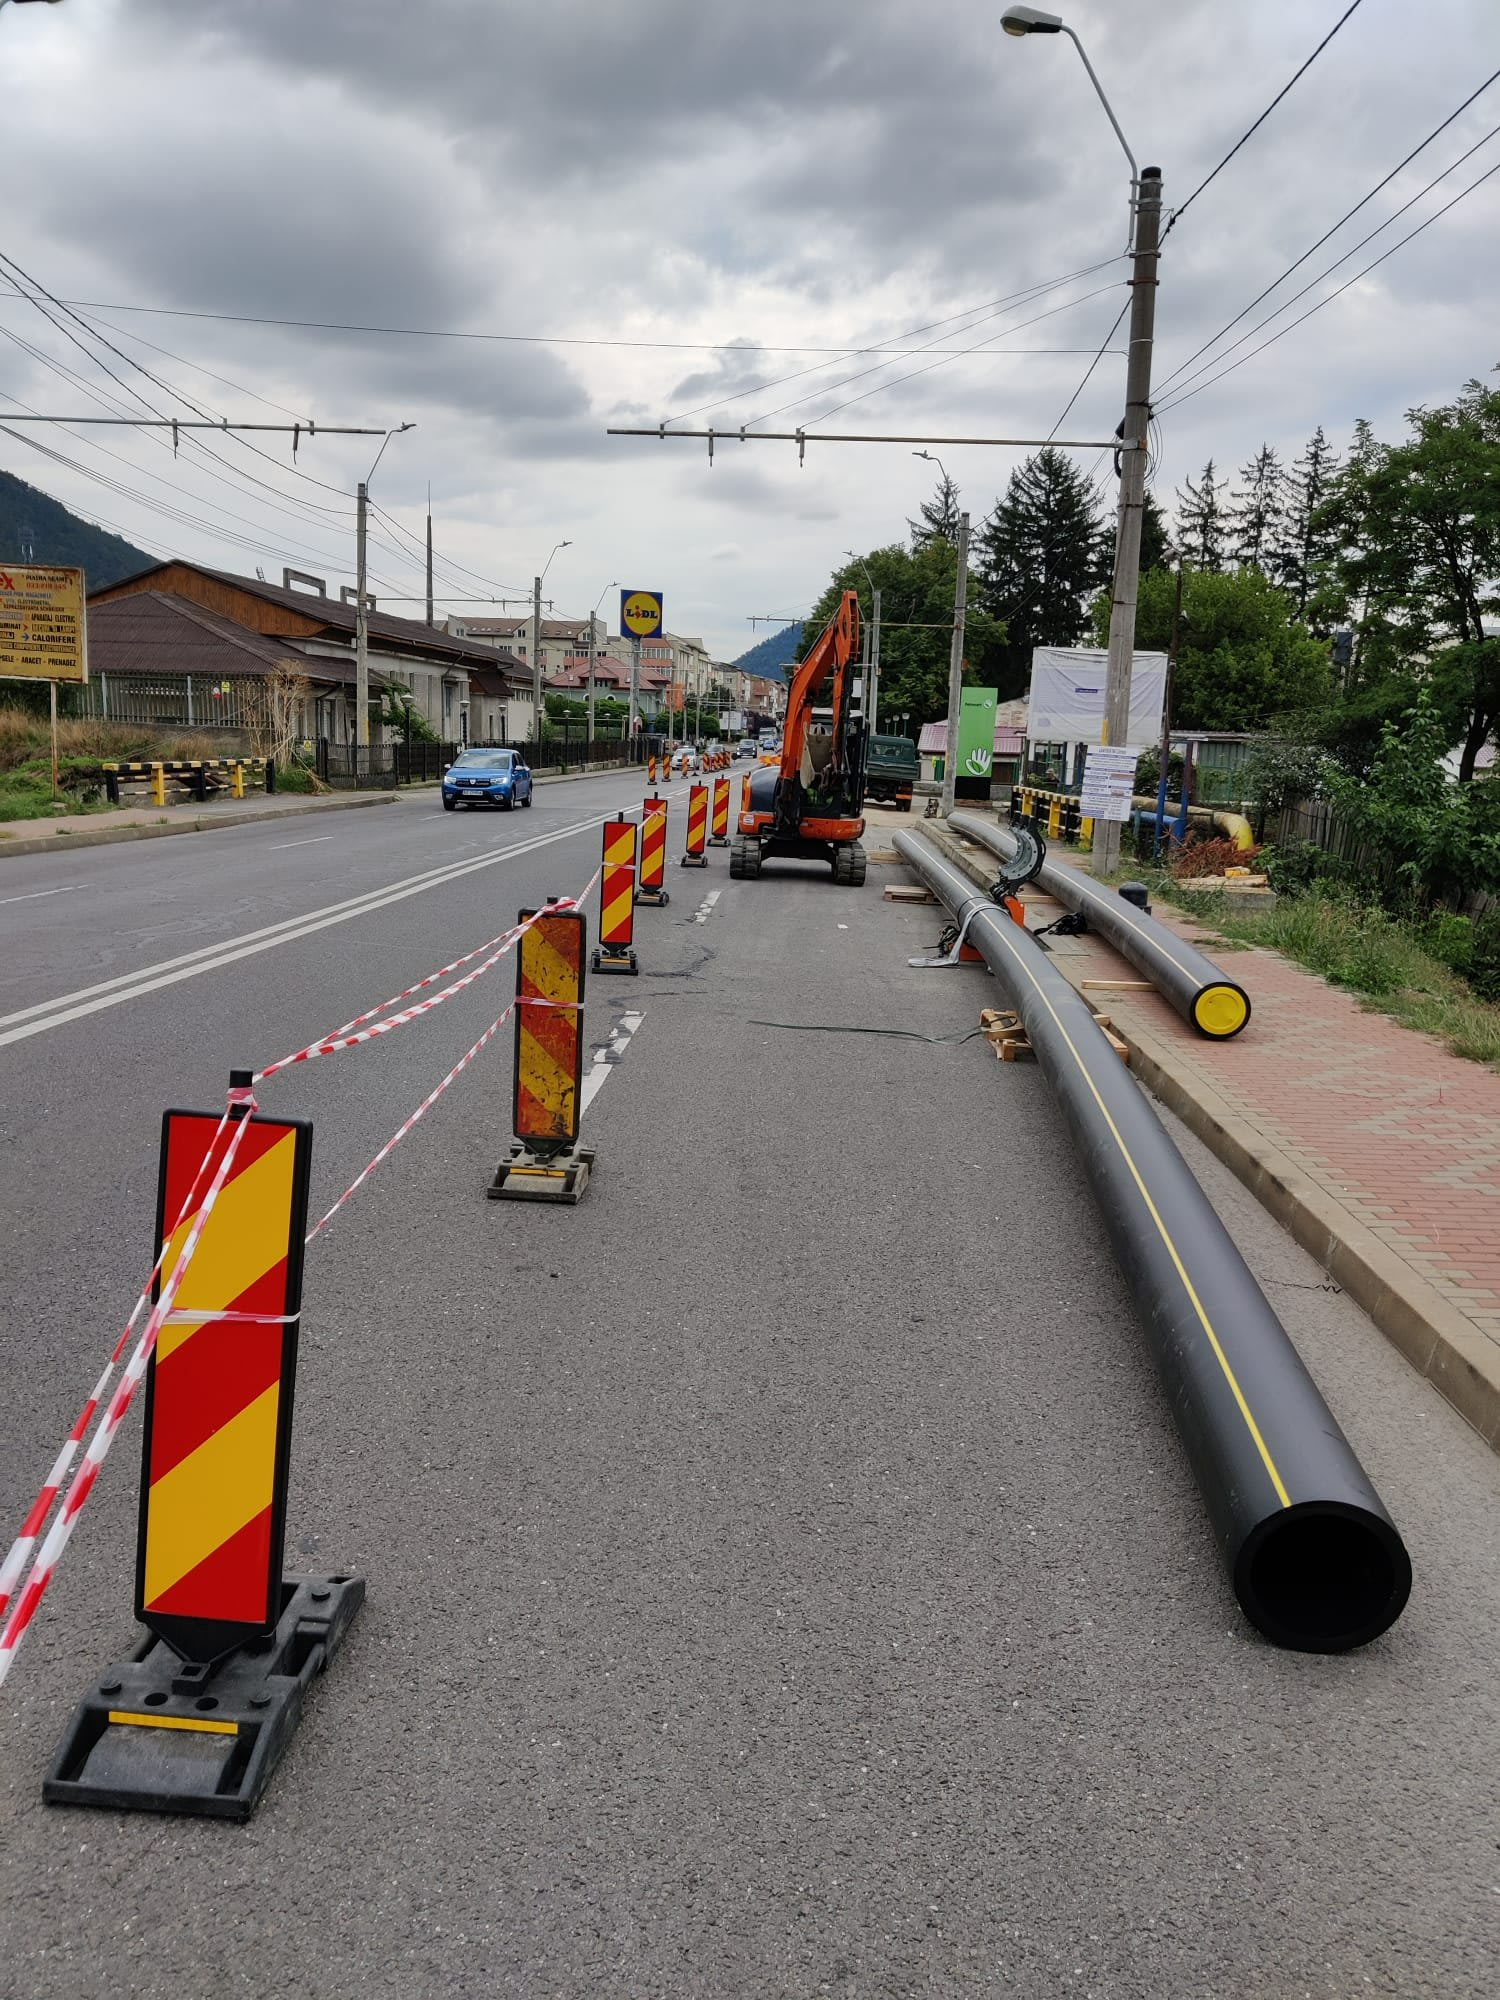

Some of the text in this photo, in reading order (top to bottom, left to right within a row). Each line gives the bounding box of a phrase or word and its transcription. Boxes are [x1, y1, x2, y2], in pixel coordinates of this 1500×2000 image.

[626, 604, 658, 619] LIDL
[54, 614, 76, 623] ELECTRIC
[32, 634, 76, 644] CALORIFERE
[0, 655, 14, 663] SELE
